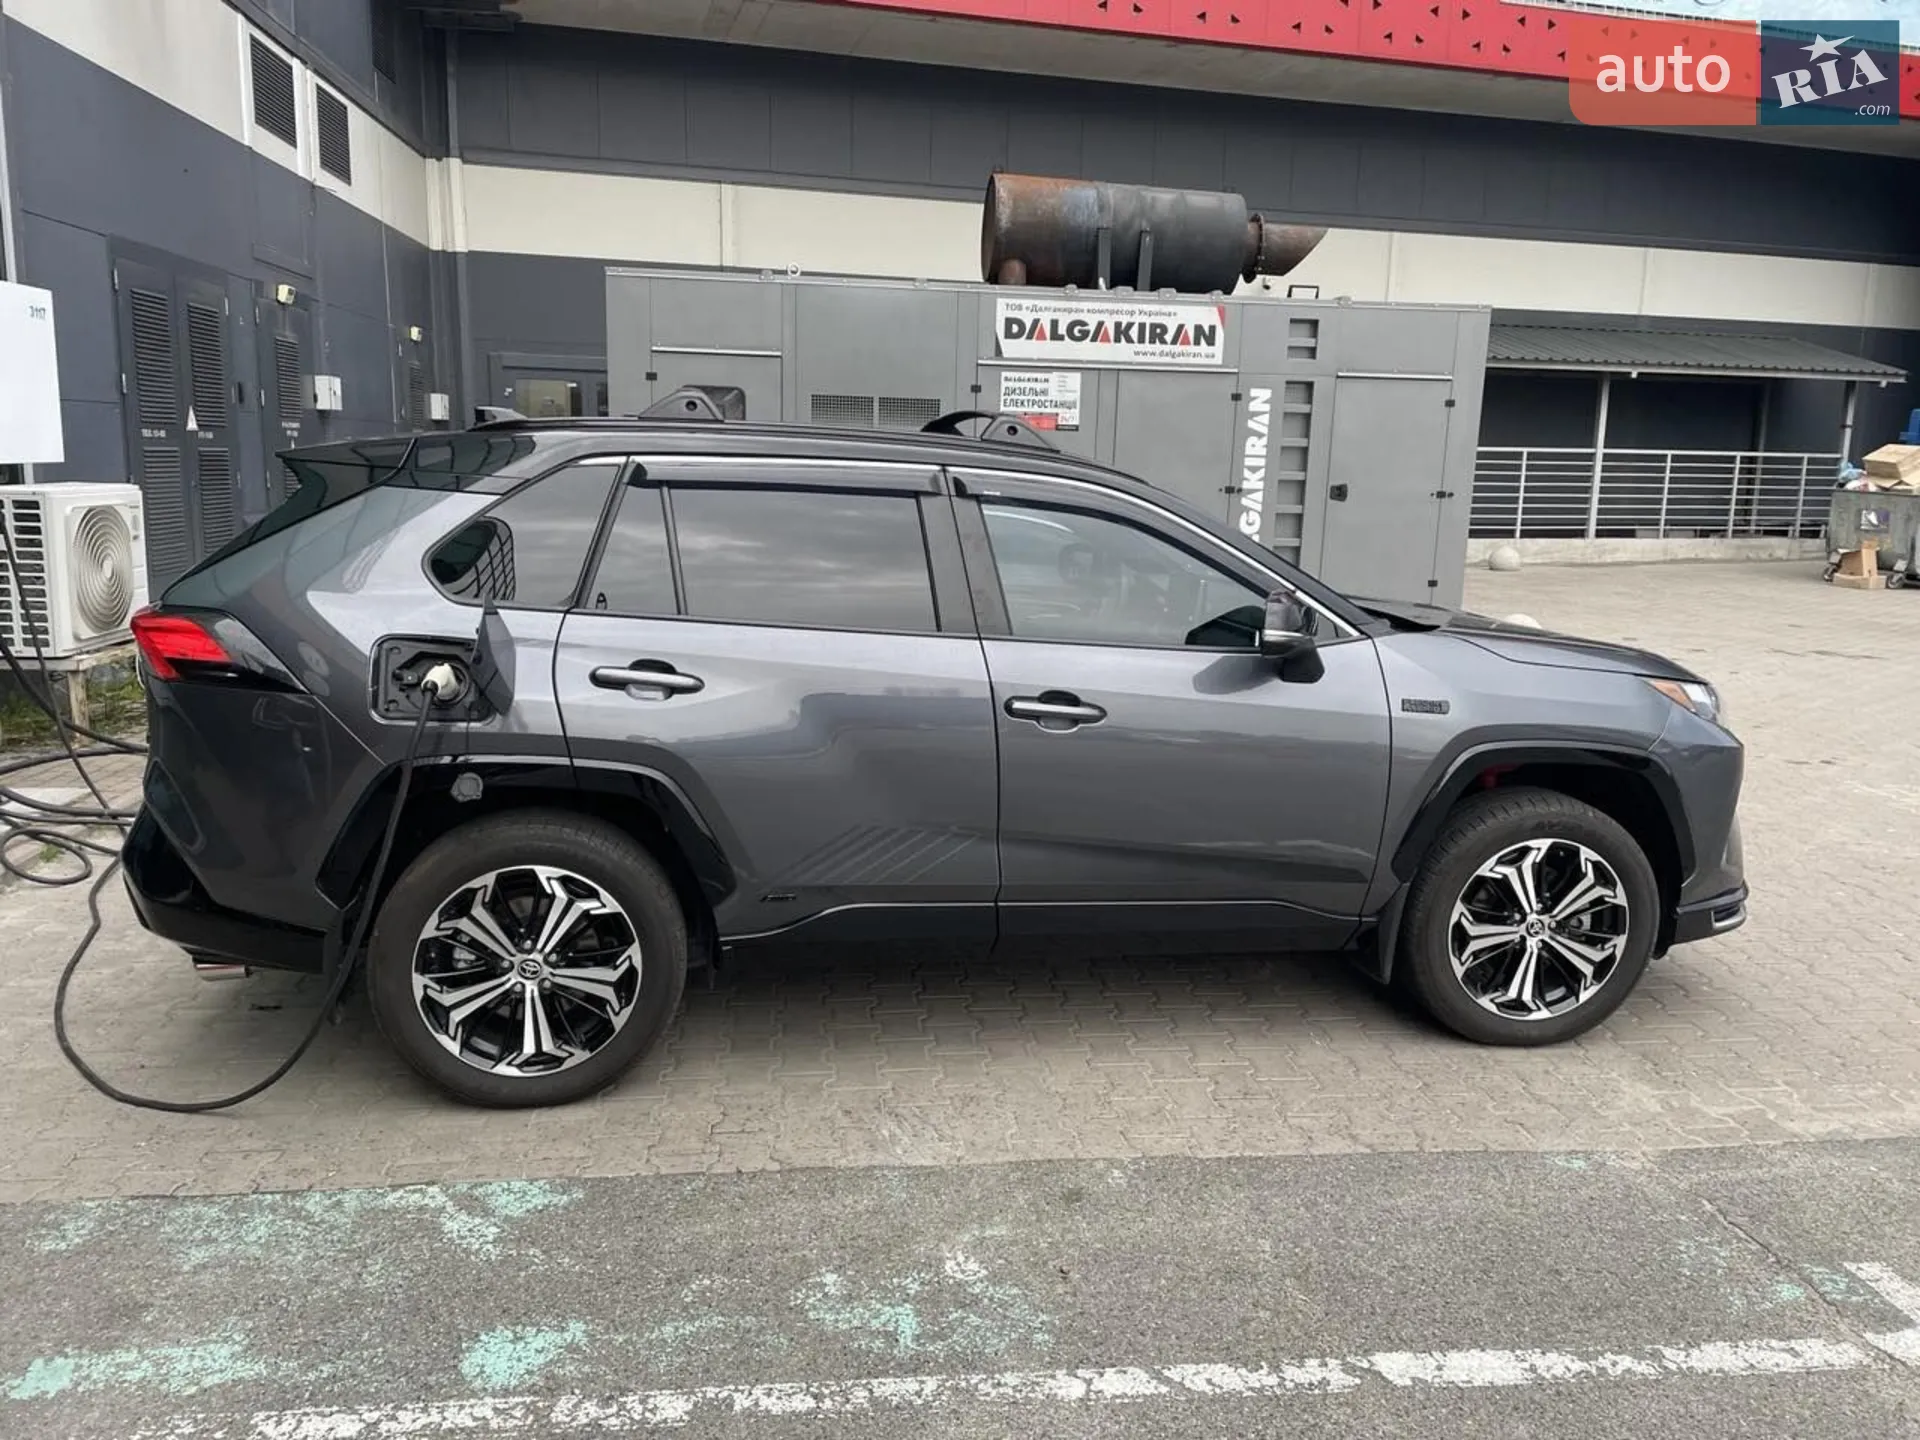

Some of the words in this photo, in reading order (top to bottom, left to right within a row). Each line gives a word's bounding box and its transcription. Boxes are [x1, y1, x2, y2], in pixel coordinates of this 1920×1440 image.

[1004, 303, 1023, 312] ТОВ
[1003, 316, 1217, 347] DALGAKIRAN
[1133, 349, 1216, 359] www.dalgakiran.ua
[1003, 386, 1049, 397] ДИЗЕЛЬНІ
